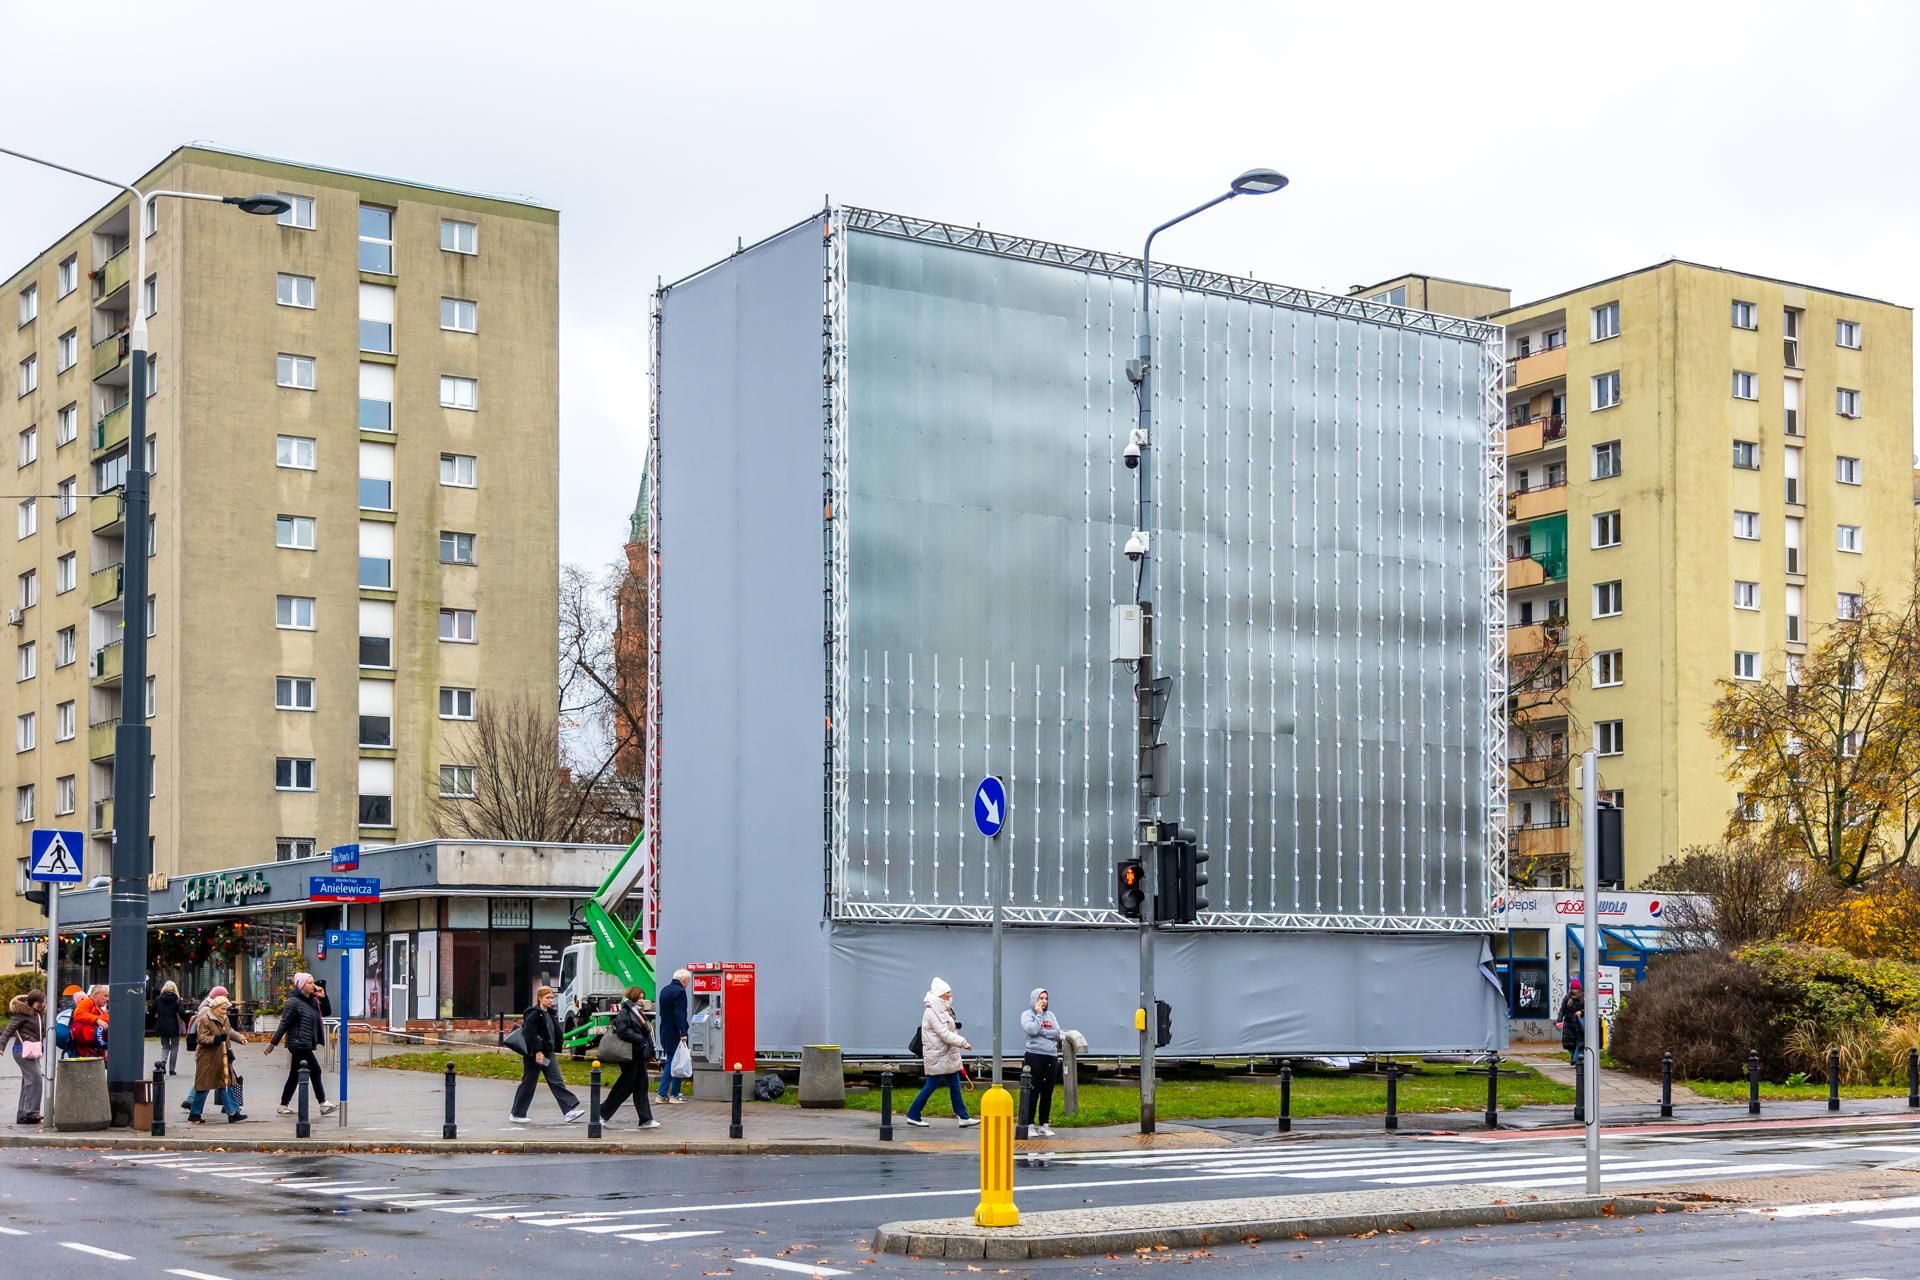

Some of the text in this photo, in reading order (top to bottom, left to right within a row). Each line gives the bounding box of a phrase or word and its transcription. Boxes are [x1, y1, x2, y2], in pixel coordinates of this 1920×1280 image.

[320, 882, 372, 894] Anielewicza
[1508, 899, 1537, 912] pepsi
[1598, 900, 1628, 913] WOLA
